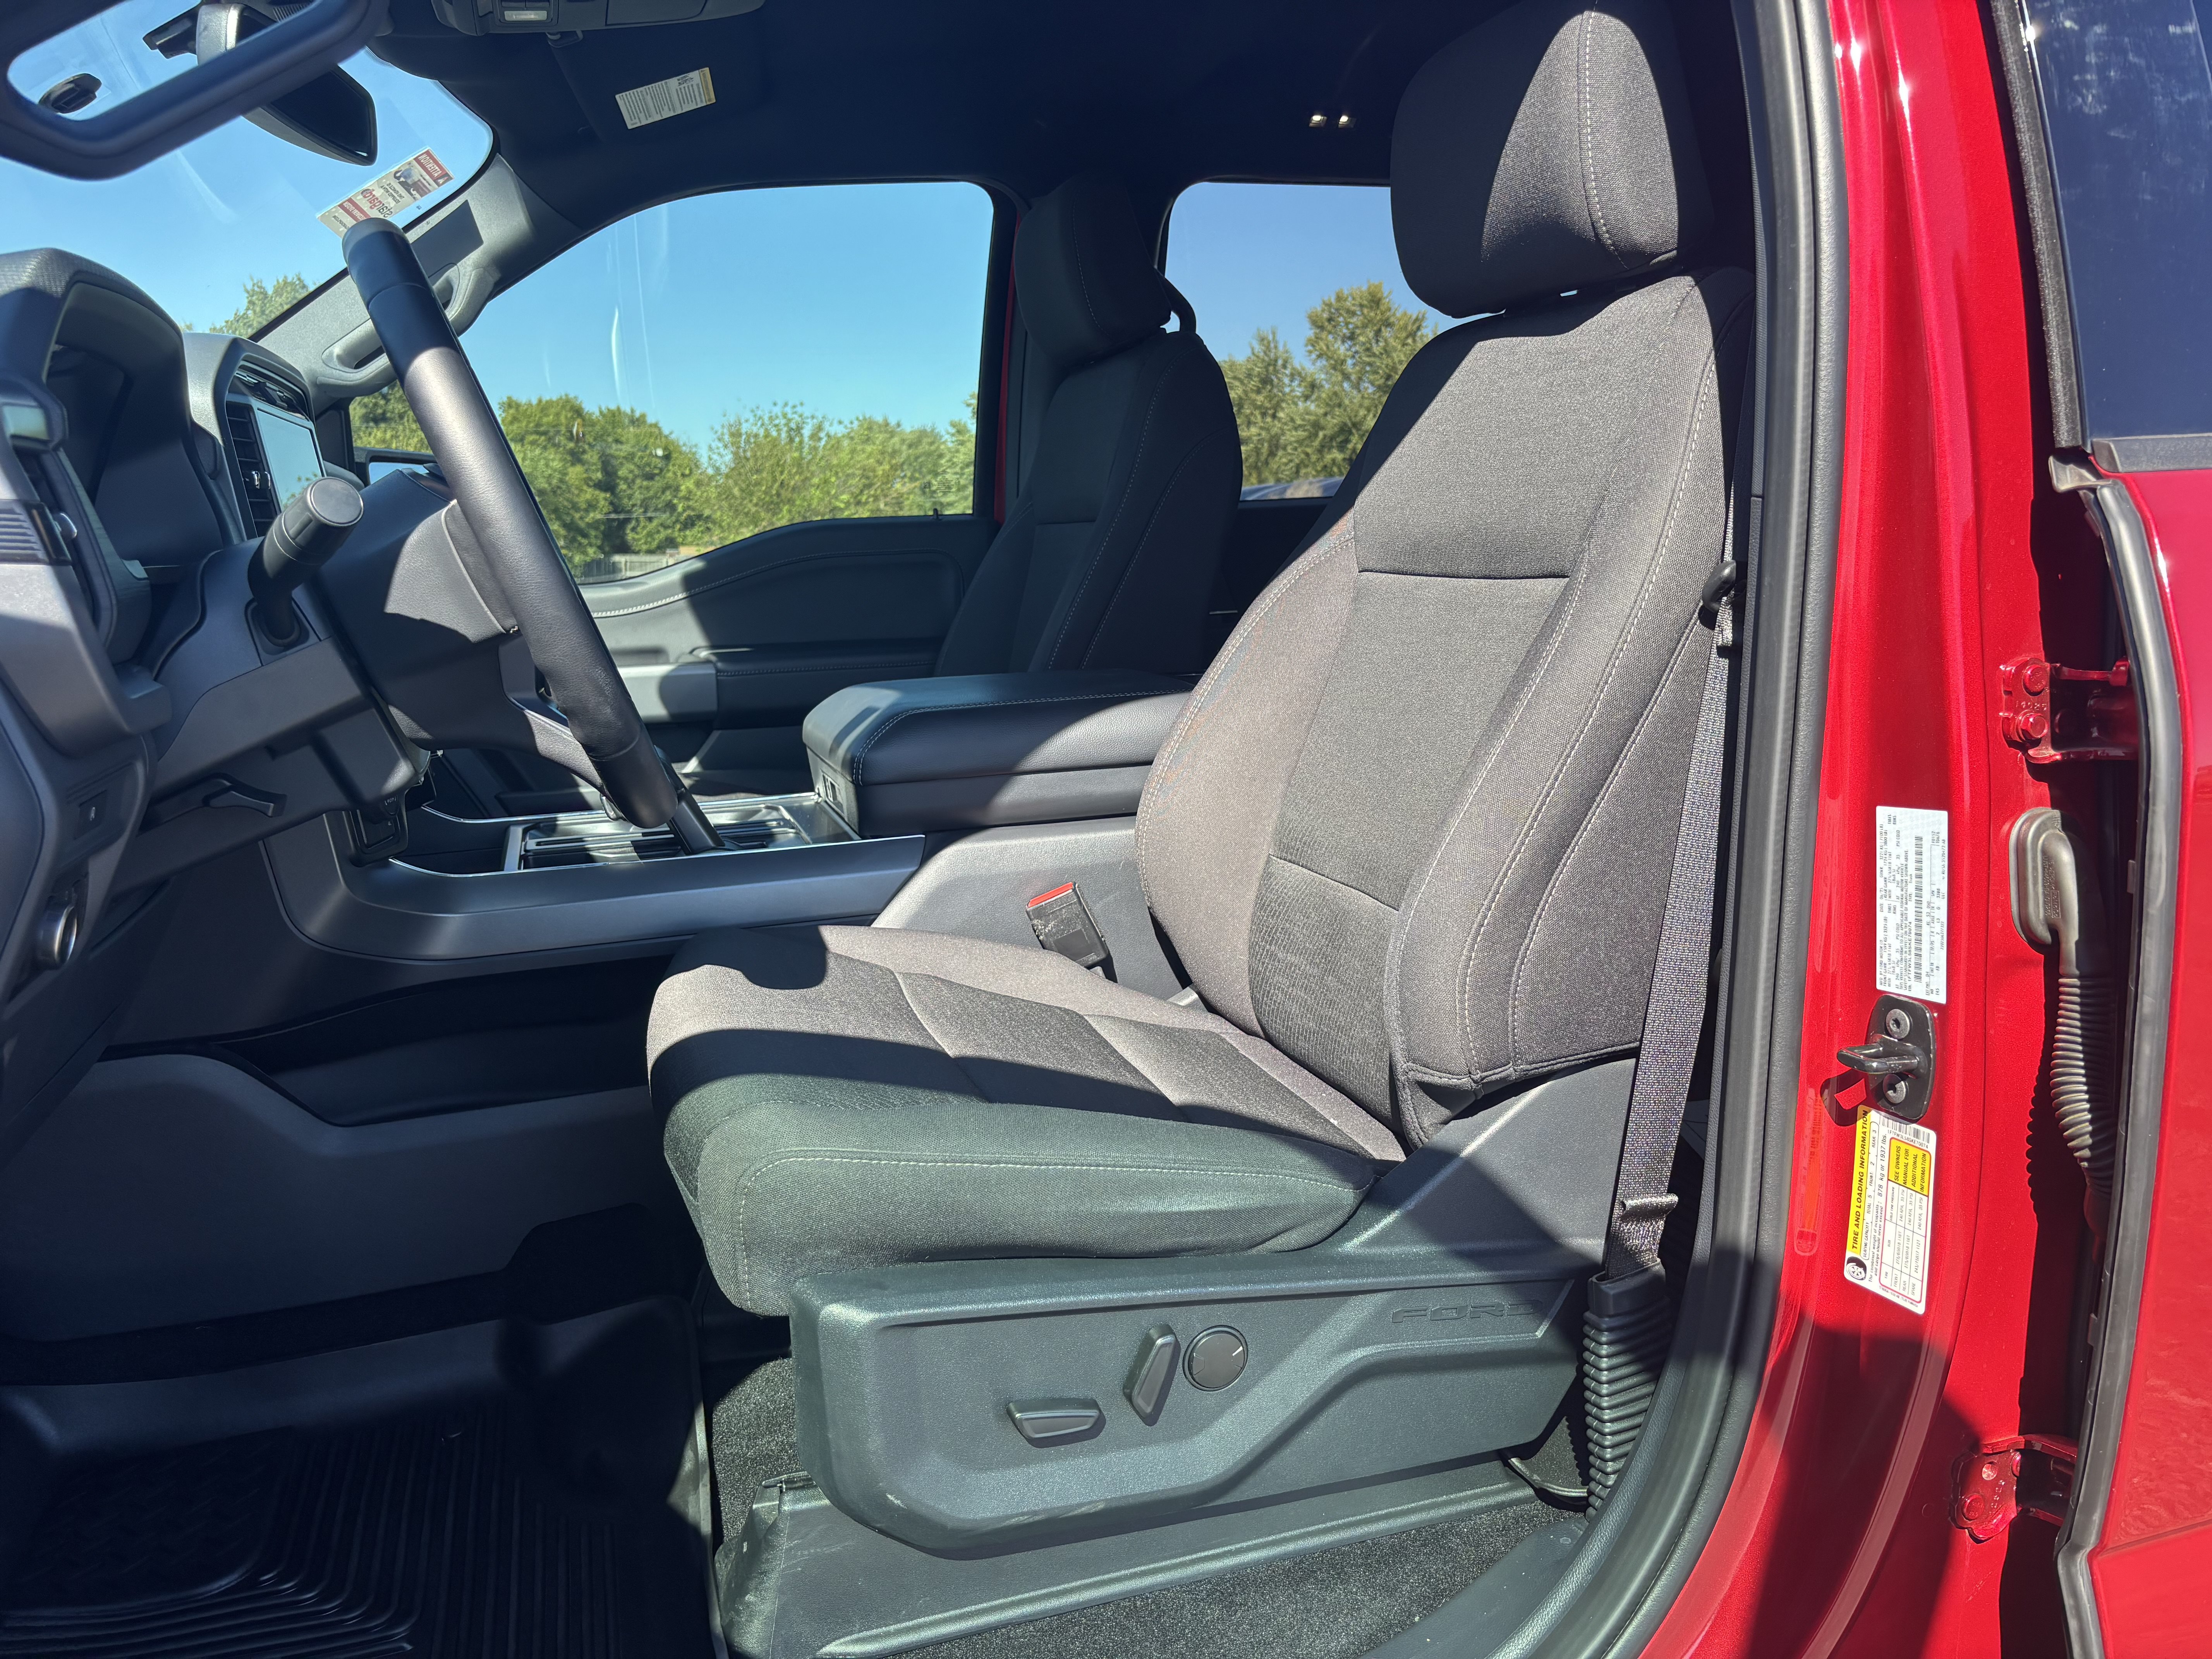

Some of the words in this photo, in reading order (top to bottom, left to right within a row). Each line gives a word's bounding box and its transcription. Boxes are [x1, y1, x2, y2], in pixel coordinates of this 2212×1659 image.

[1858, 1109, 1869, 1169] INFORMATION
[1856, 1170, 1864, 1209] LOADING
[1879, 1172, 1884, 1182] kg
[1392, 1300, 1543, 1323] FORD
